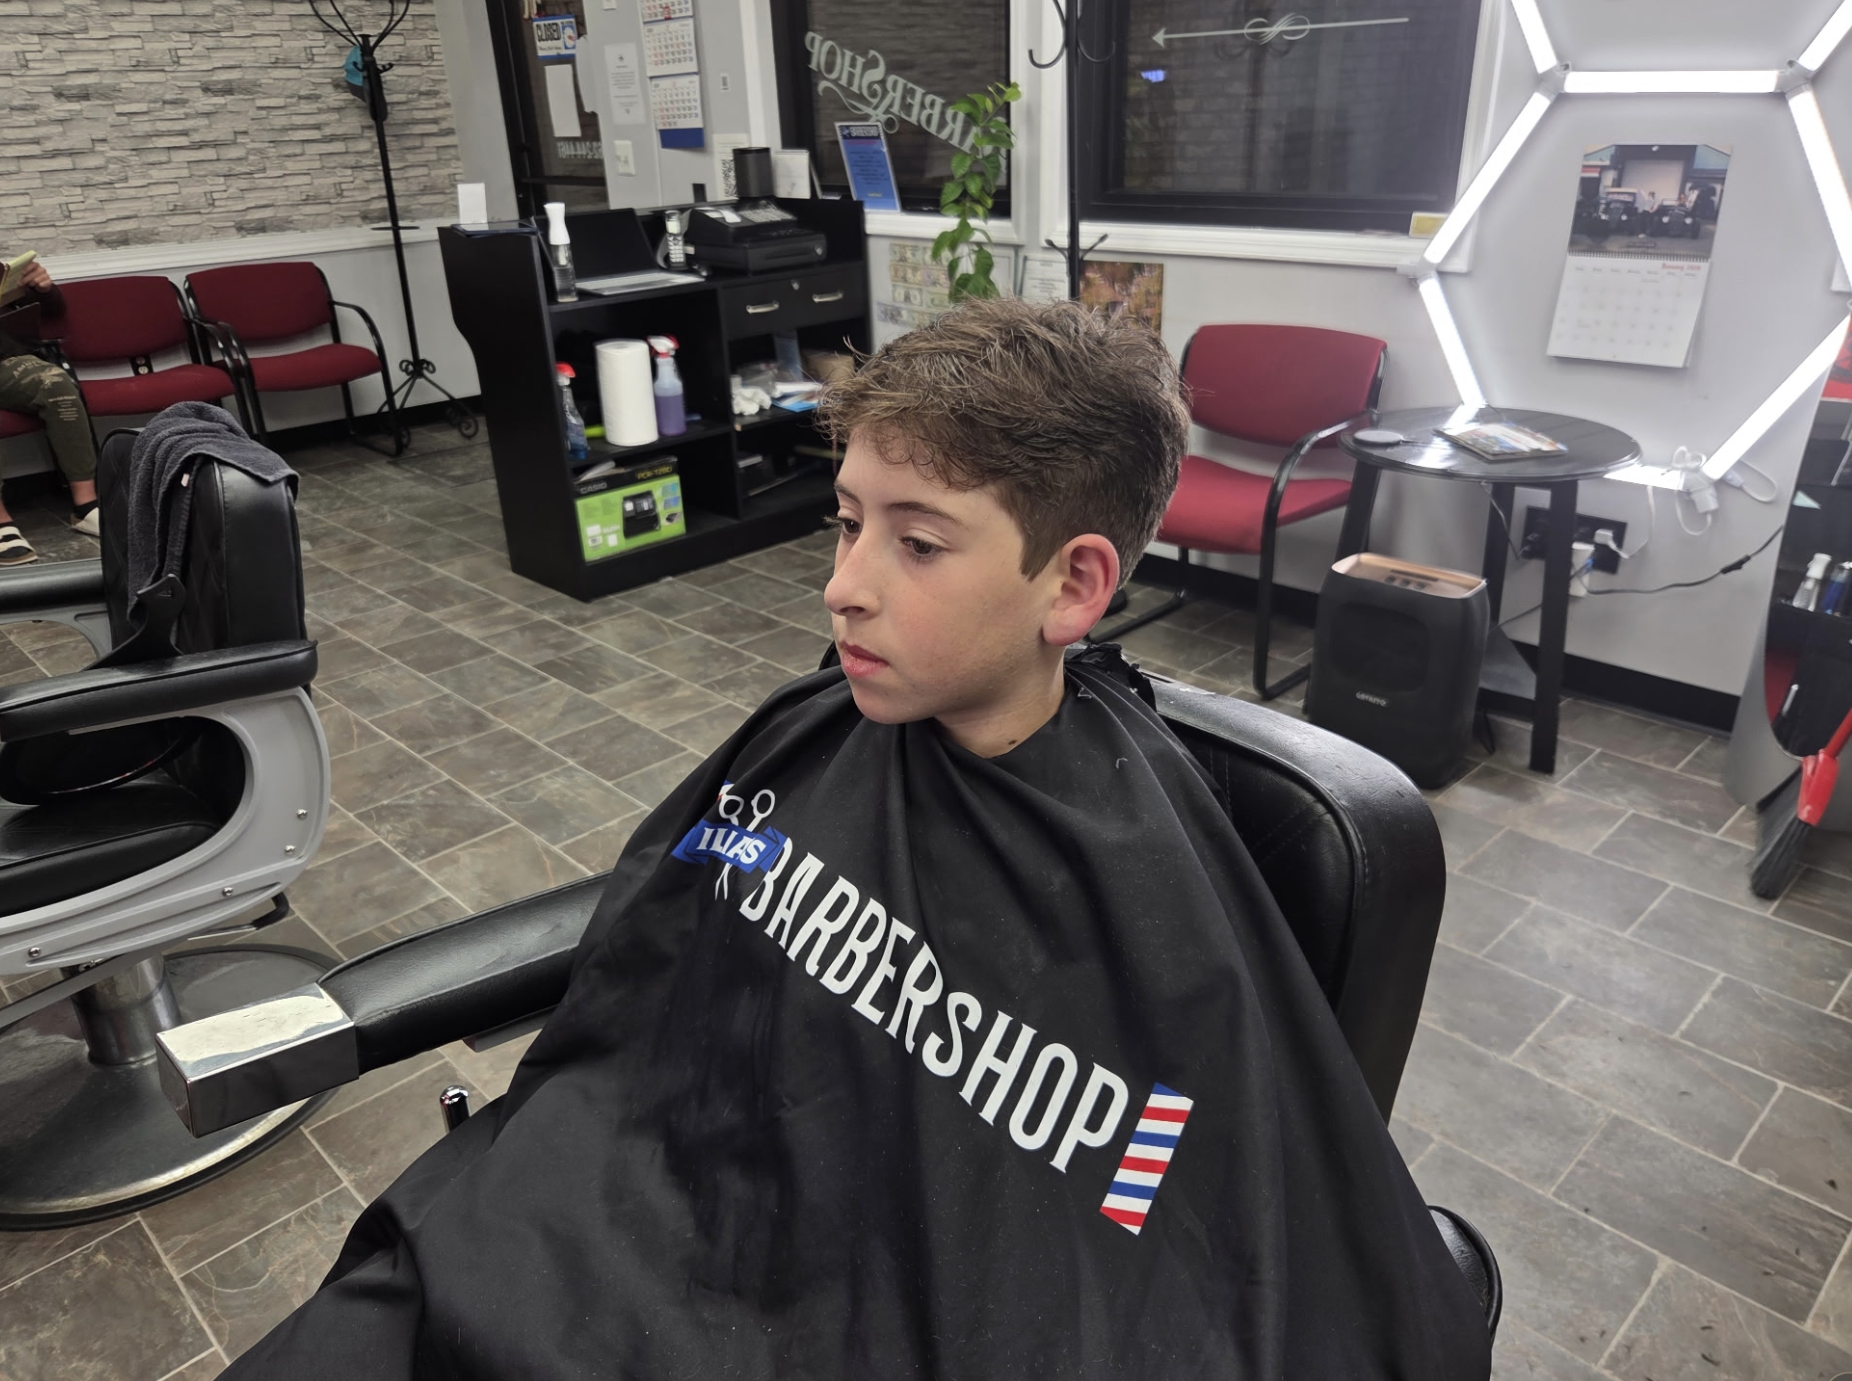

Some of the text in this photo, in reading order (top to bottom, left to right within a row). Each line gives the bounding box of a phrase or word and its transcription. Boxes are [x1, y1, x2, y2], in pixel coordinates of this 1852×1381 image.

[536, 22, 561, 42] CLOSED
[580, 482, 607, 494] CASIO
[739, 837, 1129, 1173] BARBERSHOP
